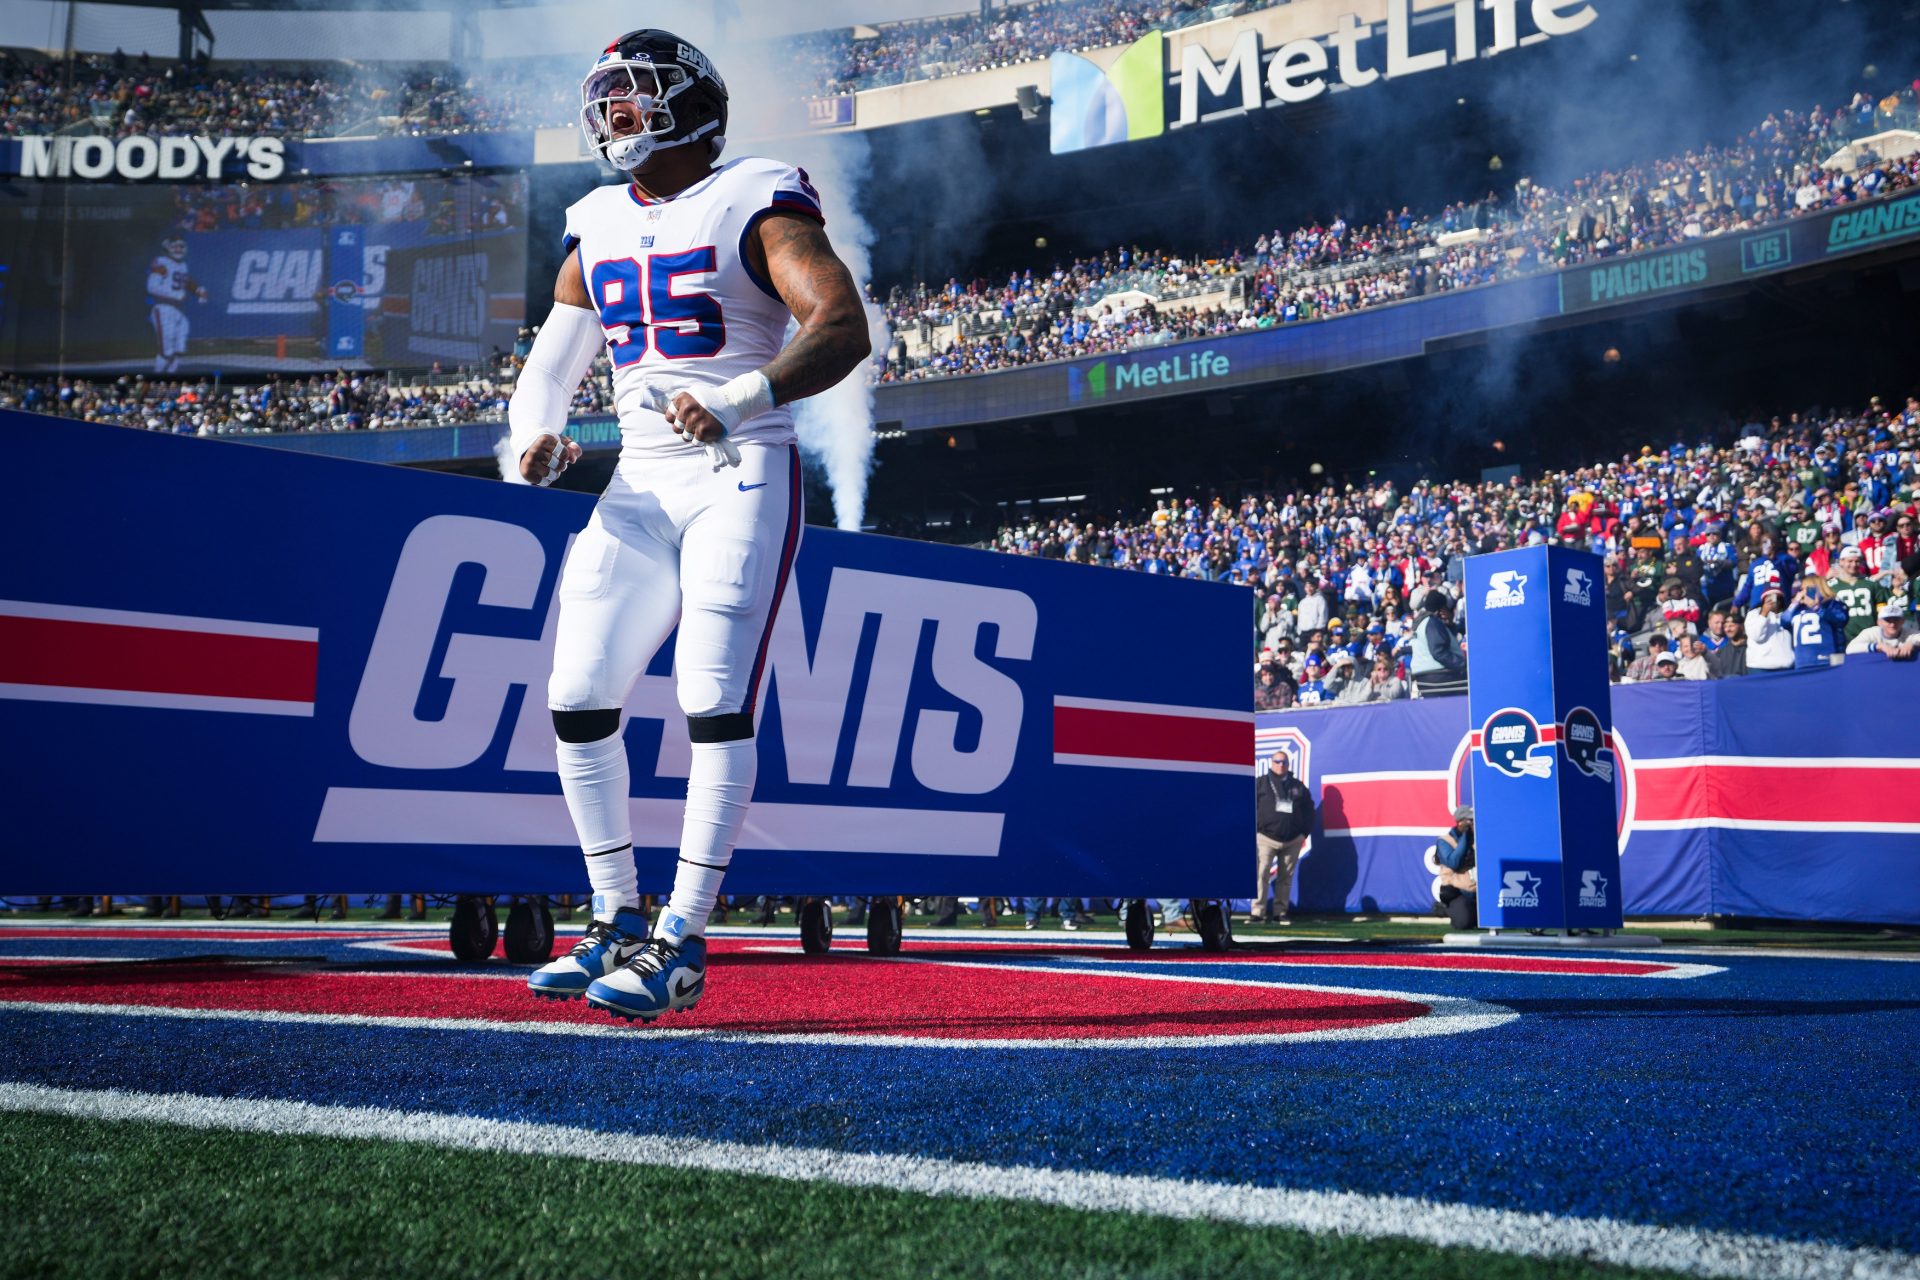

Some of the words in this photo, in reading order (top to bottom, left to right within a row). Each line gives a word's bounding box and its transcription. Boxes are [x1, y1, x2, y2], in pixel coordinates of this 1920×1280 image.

[1179, 0, 1599, 126] MetLife
[20, 135, 285, 180] MOODY'S
[1751, 237, 1781, 265] VS
[1589, 249, 1708, 301] PACKERS
[591, 245, 727, 371] 95
[1115, 350, 1230, 391] MetLife
[1485, 595, 1525, 610] STARTER
[1491, 724, 1527, 742] GIANTS
[1497, 897, 1539, 908] STARTER
